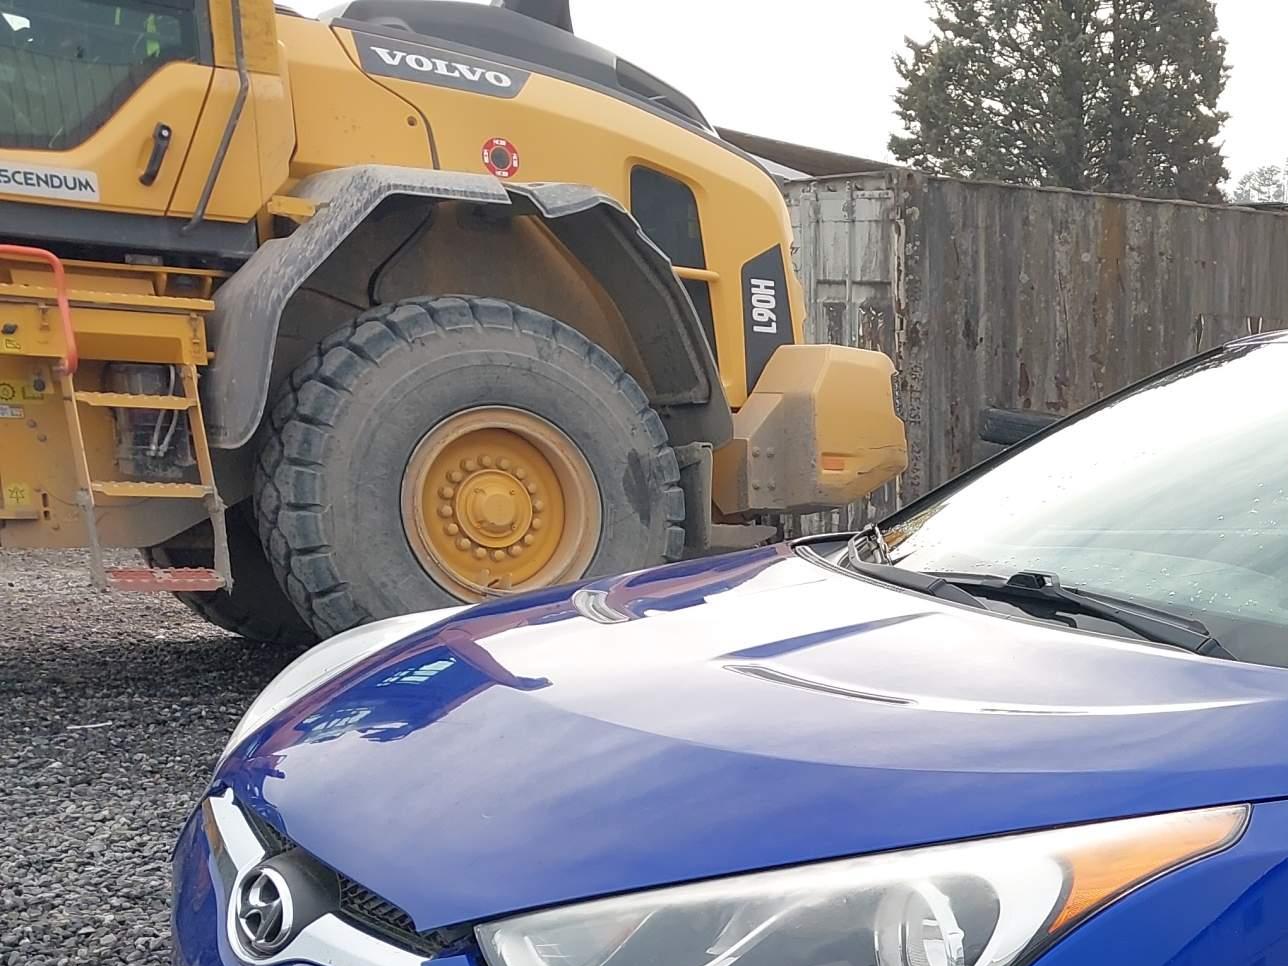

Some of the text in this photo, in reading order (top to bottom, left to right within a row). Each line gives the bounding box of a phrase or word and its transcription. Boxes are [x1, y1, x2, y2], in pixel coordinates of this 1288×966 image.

[370, 46, 512, 87] VOLVO
[0, 169, 95, 192] SCENDUM
[750, 278, 777, 334] L90H
